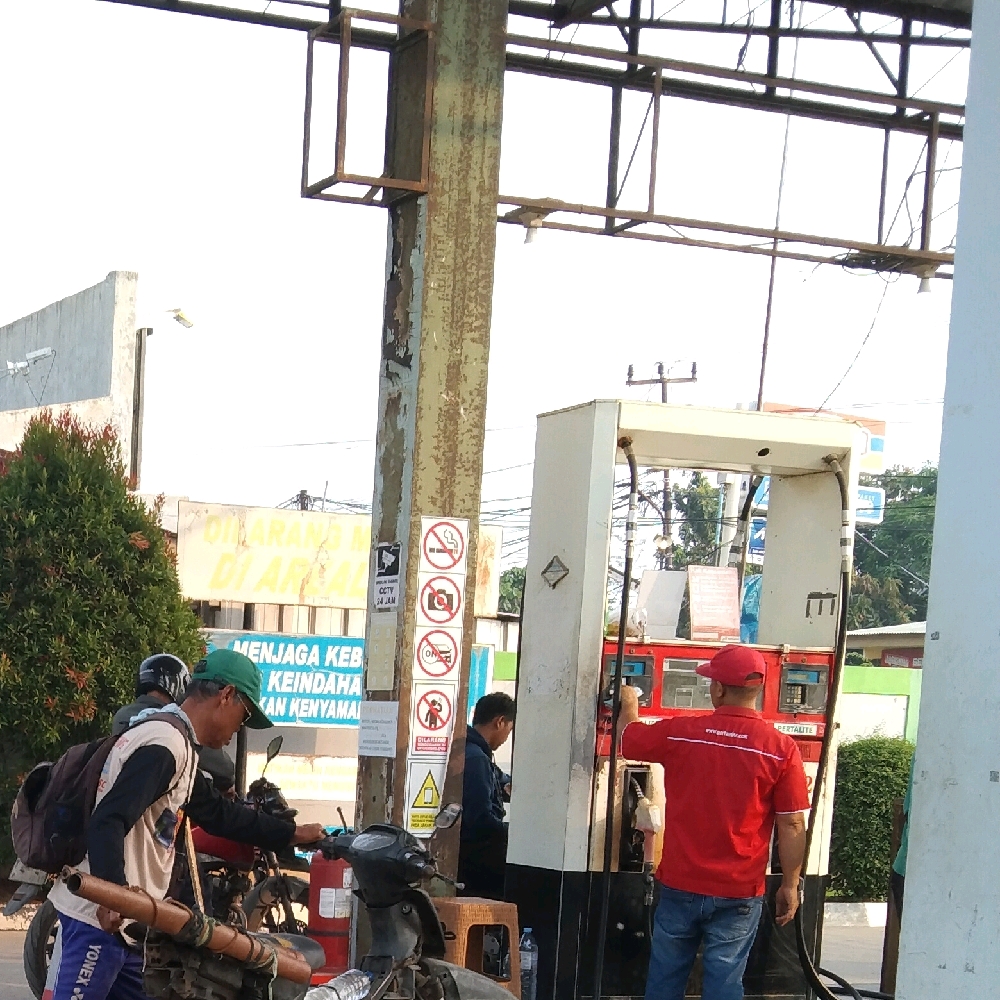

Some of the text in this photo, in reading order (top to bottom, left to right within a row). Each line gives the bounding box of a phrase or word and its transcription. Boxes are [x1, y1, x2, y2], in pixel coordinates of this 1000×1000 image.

[208, 552, 253, 591] DI
[379, 586, 394, 595] CCTV
[233, 640, 320, 667] MENJAGA
[777, 725, 814, 734] PERTALITE
[75, 944, 102, 987] YONEX
